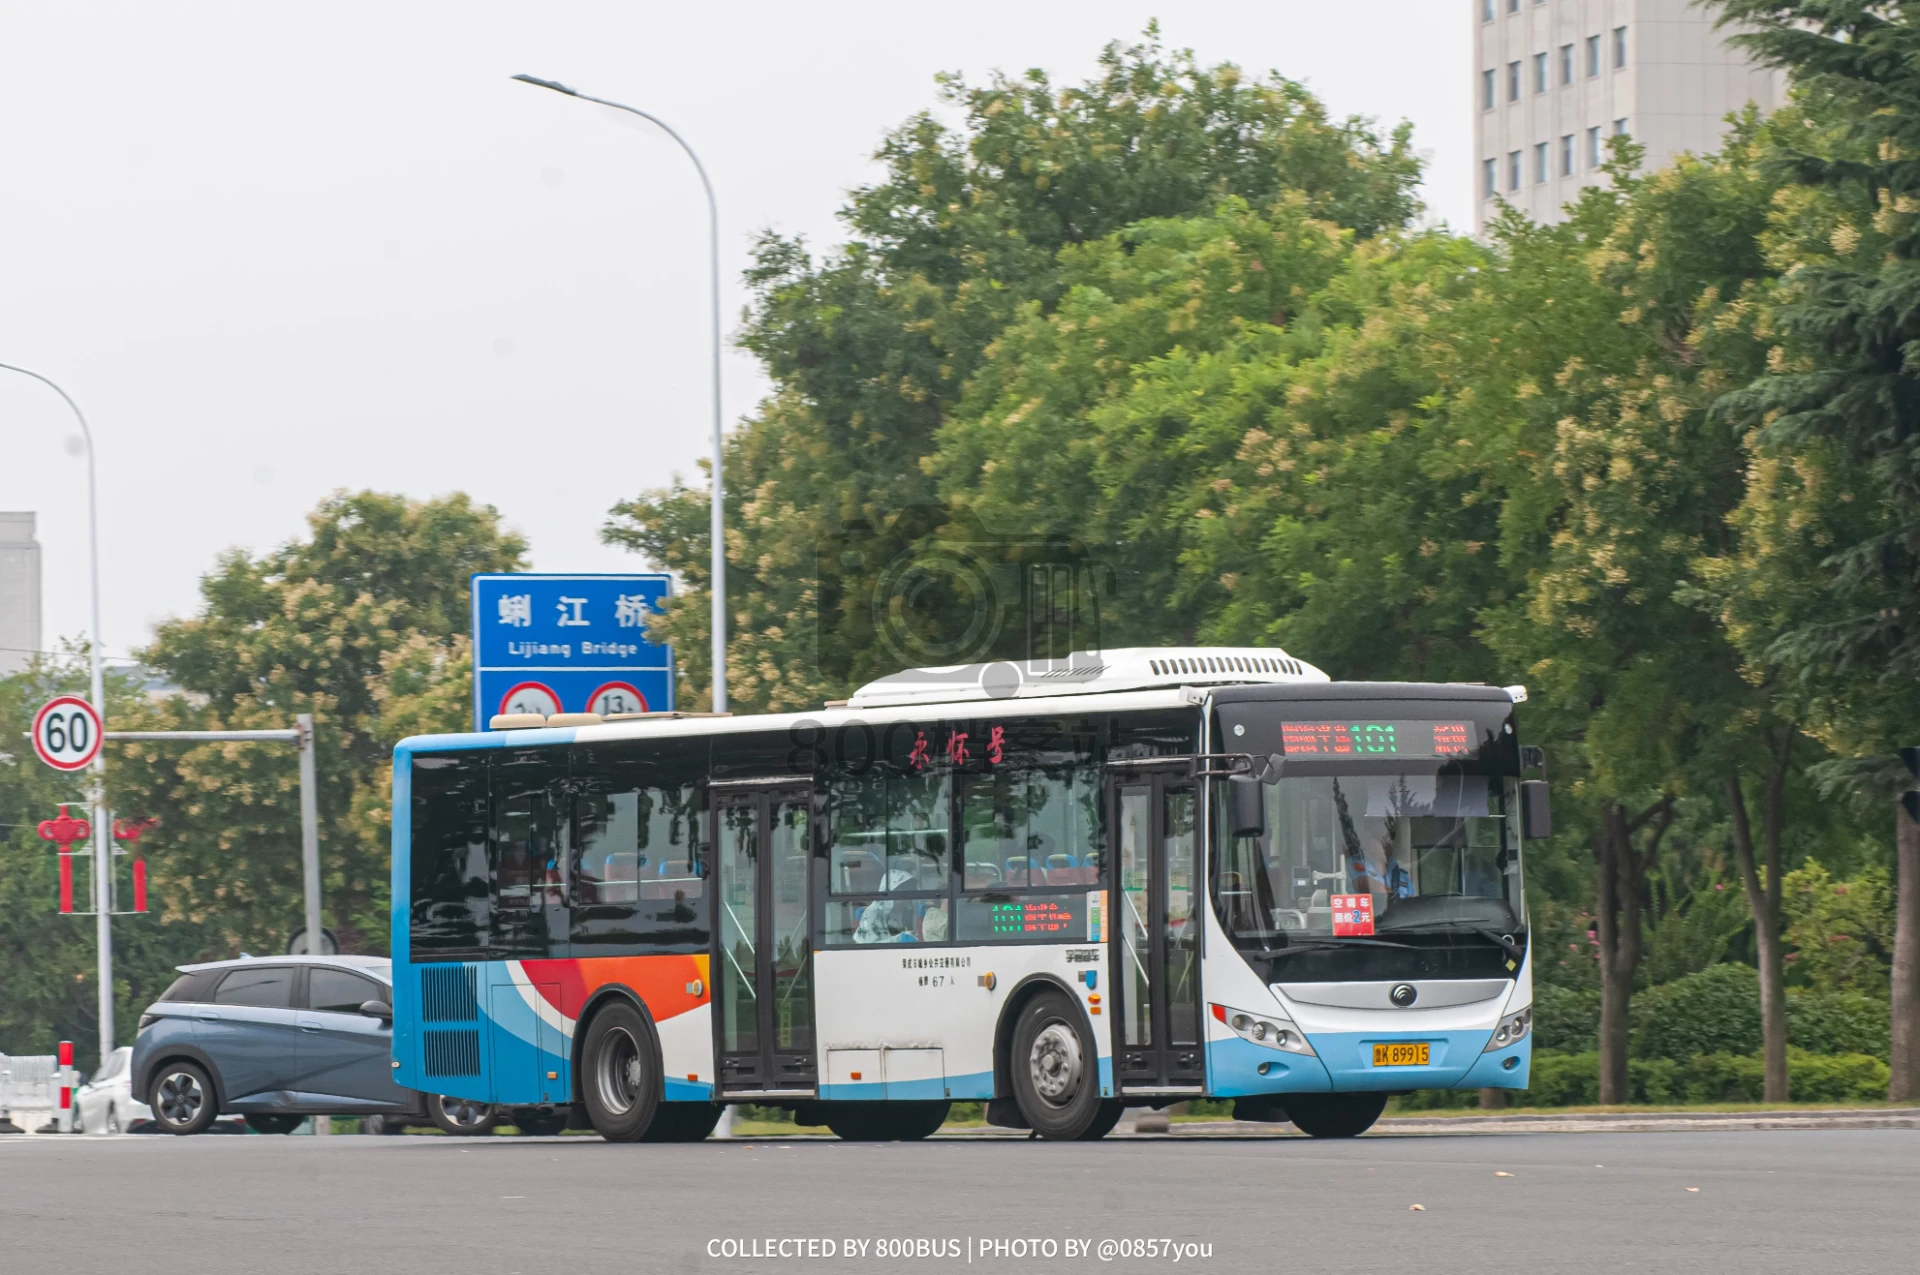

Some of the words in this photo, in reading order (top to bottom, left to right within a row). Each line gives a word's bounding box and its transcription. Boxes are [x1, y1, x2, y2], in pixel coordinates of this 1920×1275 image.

[508, 641, 571, 658] Lijiang
[581, 641, 638, 658] Bridge
[46, 712, 88, 753] 60
[932, 975, 945, 988] 67
